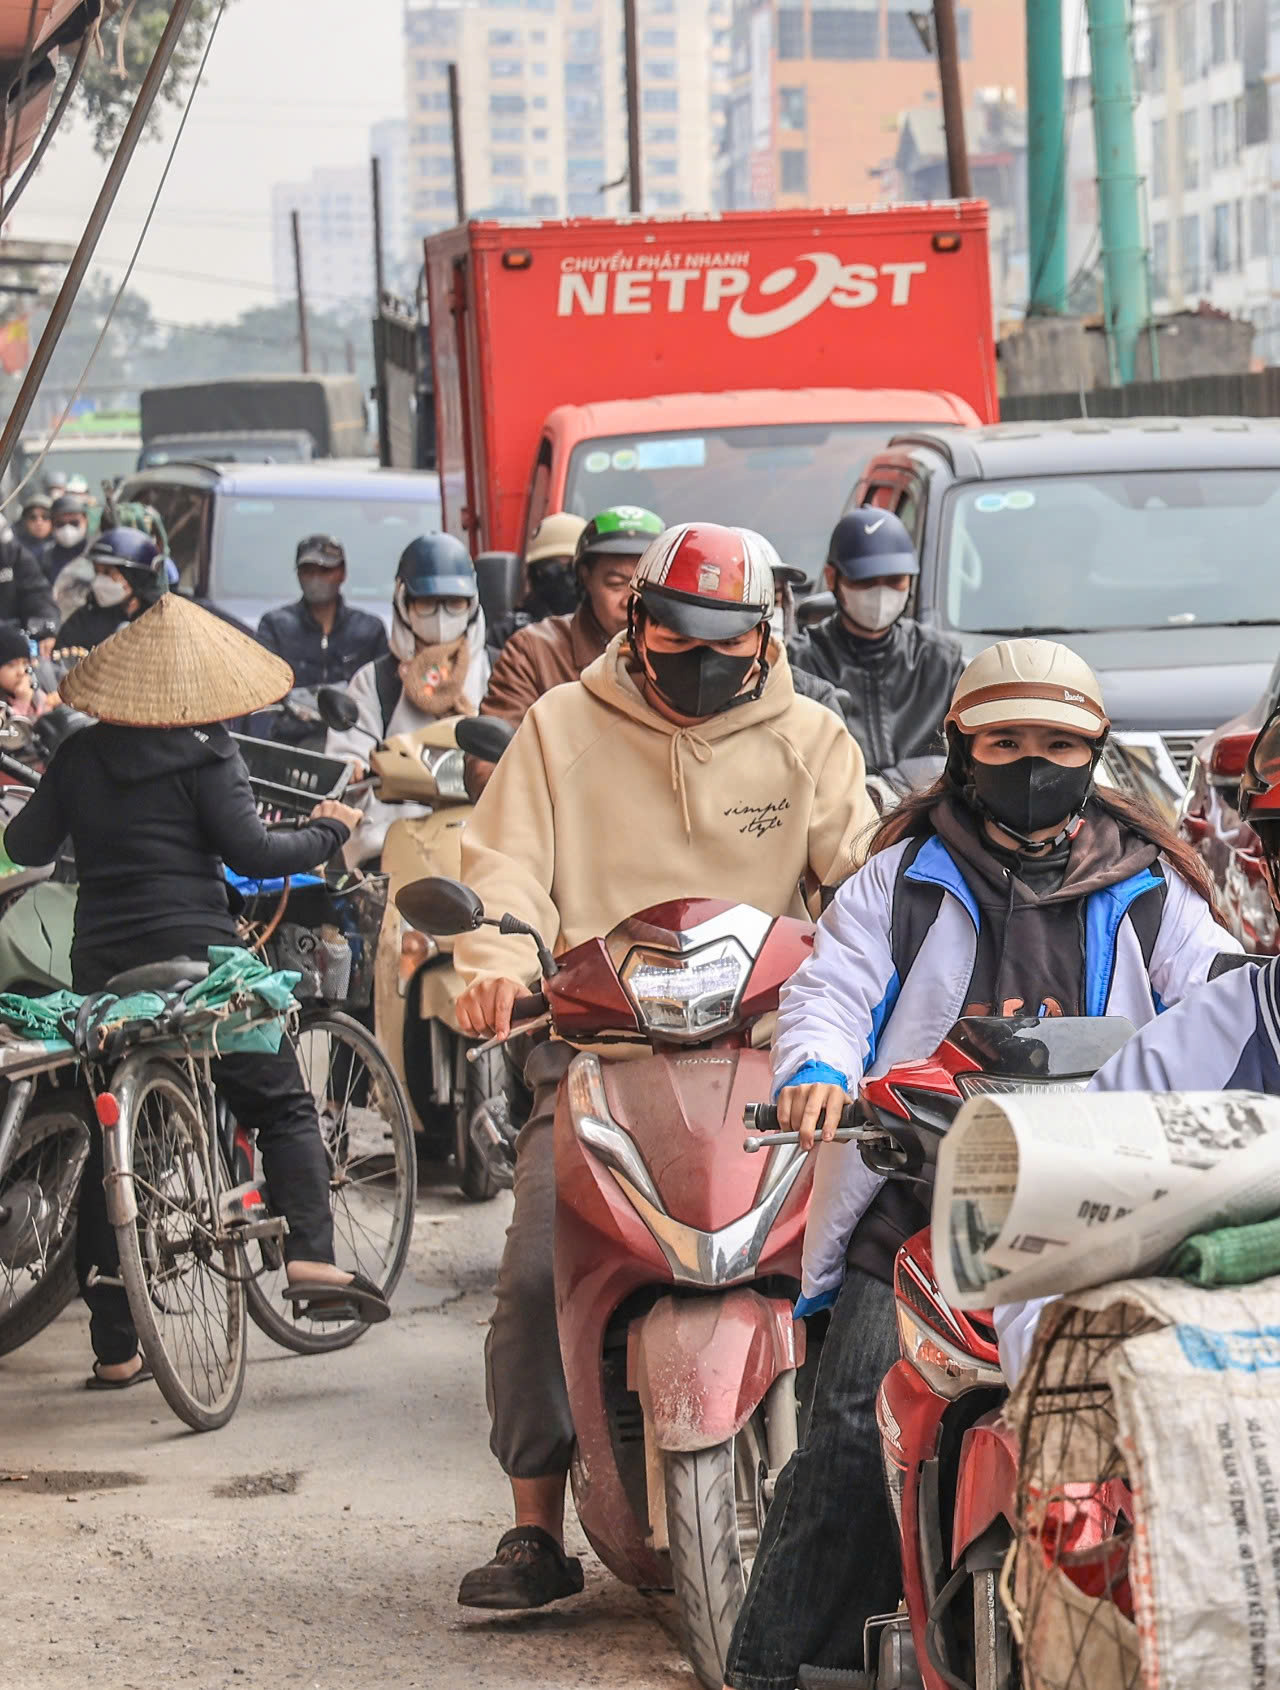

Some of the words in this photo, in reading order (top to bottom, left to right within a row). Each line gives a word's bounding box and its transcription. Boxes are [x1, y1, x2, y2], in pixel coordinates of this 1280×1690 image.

[637, 250, 681, 270] PHÁT
[684, 251, 750, 269] NHANH
[557, 252, 926, 338] NETPOST
[723, 798, 791, 820] simple
[739, 816, 784, 838] style
